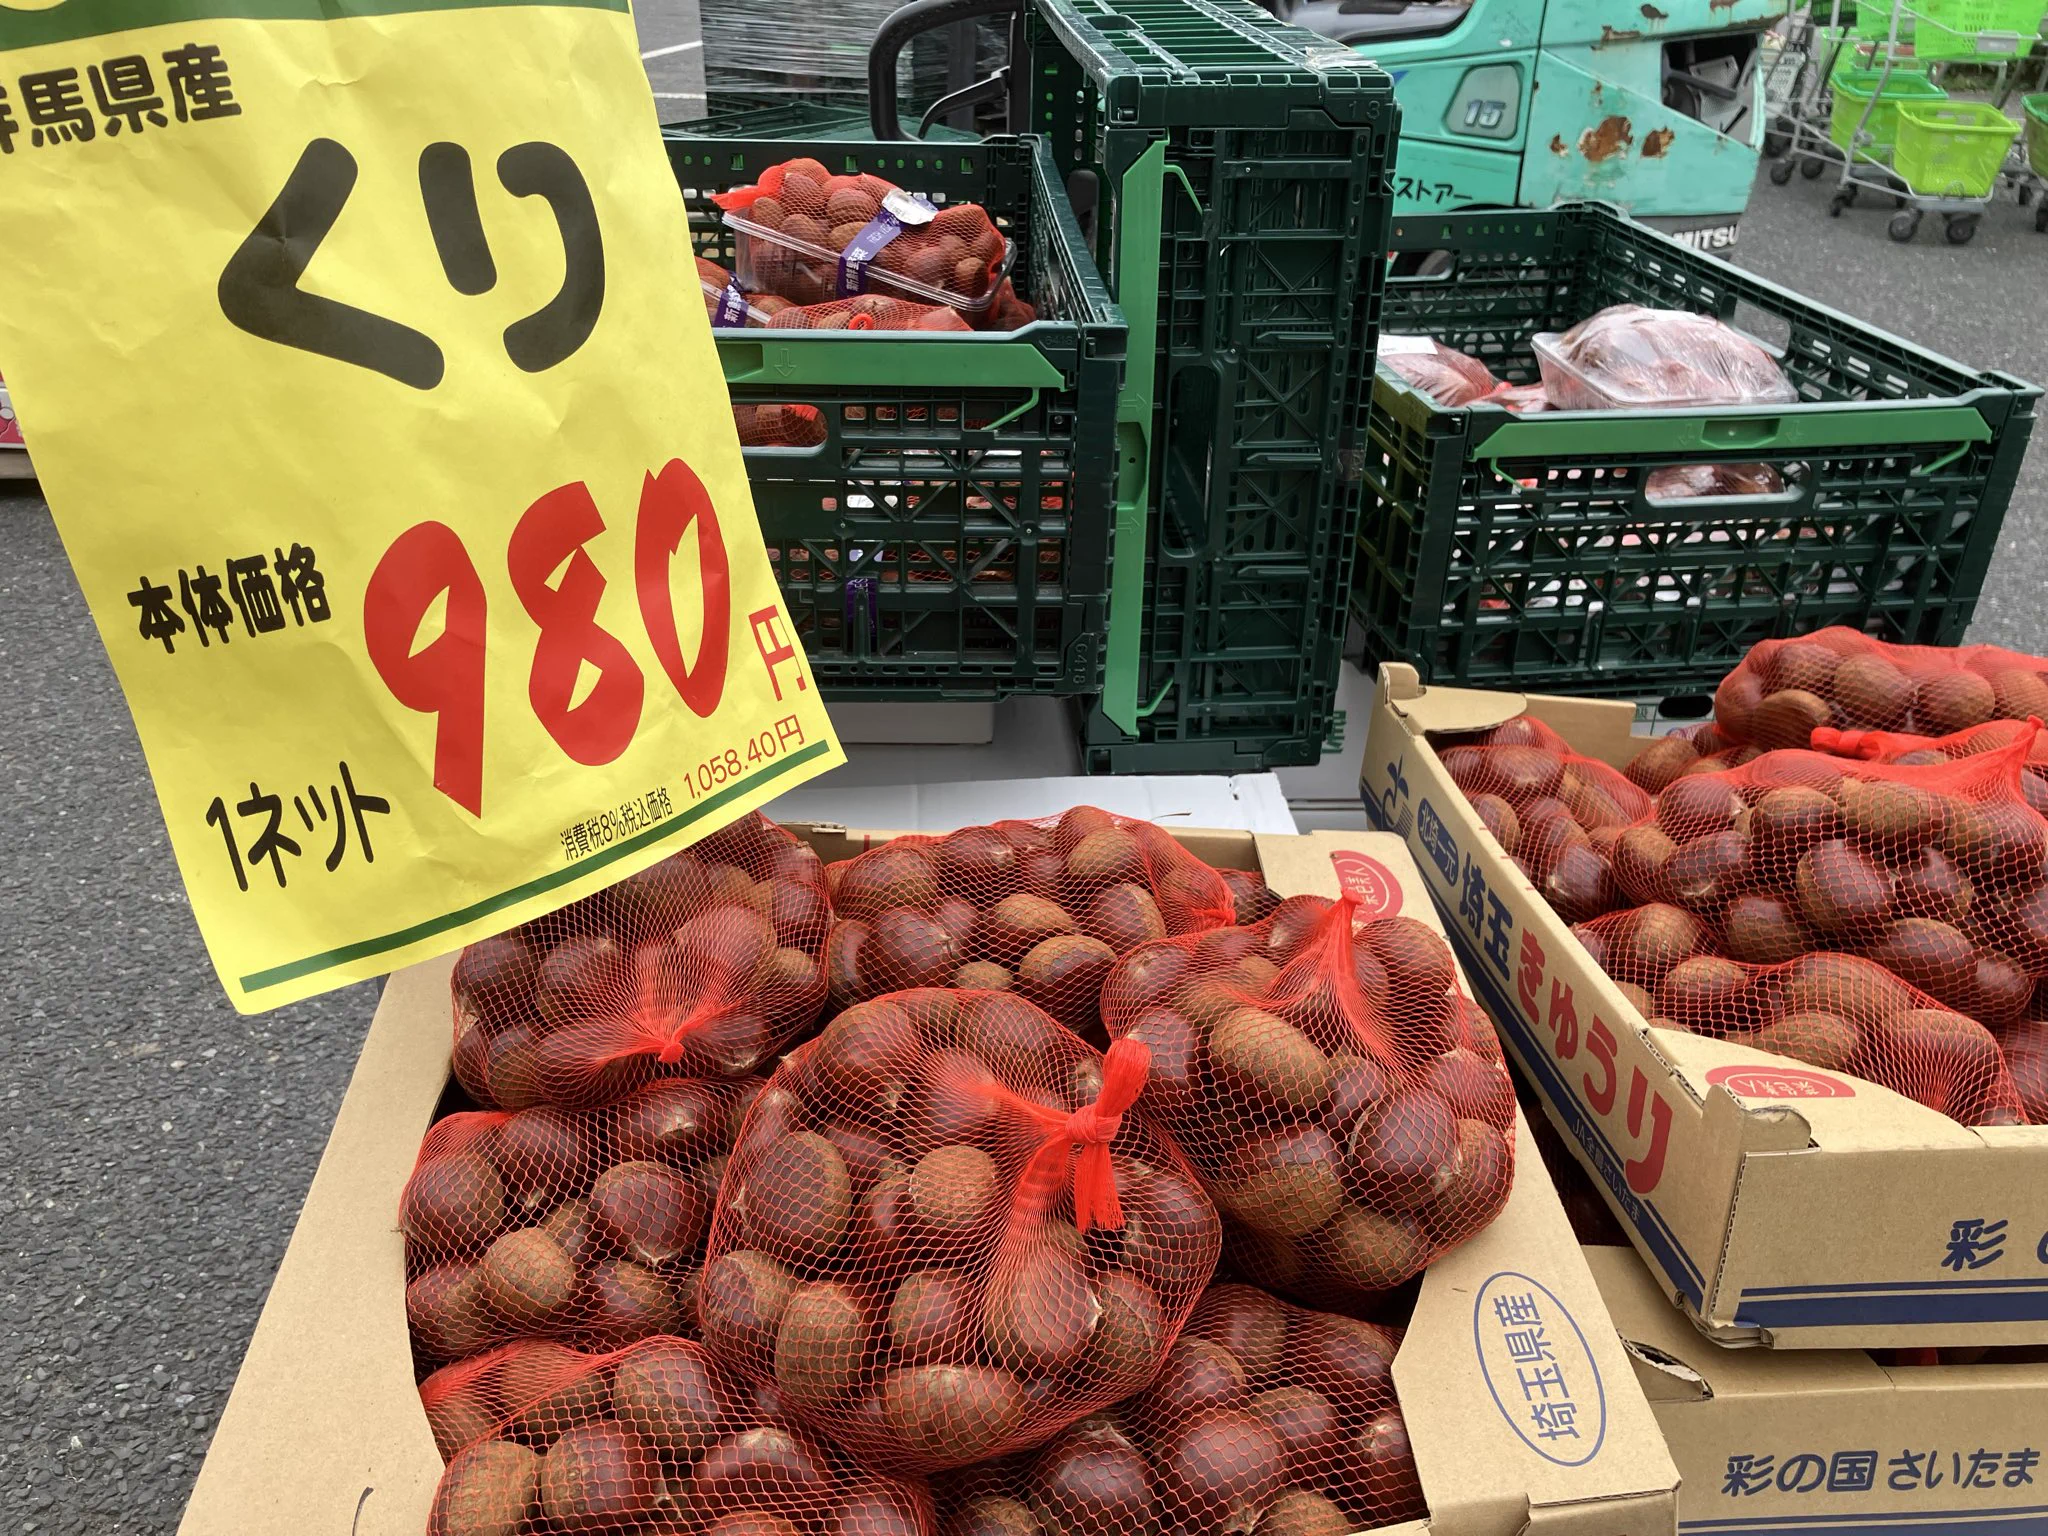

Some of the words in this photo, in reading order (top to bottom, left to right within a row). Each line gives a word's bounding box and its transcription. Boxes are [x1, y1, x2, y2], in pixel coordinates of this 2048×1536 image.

[0, 43, 242, 154] 馬県産
[1464, 99, 1507, 128] 15
[218, 138, 606, 390] くり
[126, 543, 332, 654] 本体価格
[364, 457, 730, 819] 980
[206, 761, 391, 892] 1ネット
[559, 786, 674, 861] 消費税8%税込価格
[683, 714, 805, 800] 1,058.40円
[1492, 1292, 1581, 1441] 埼玉県産
